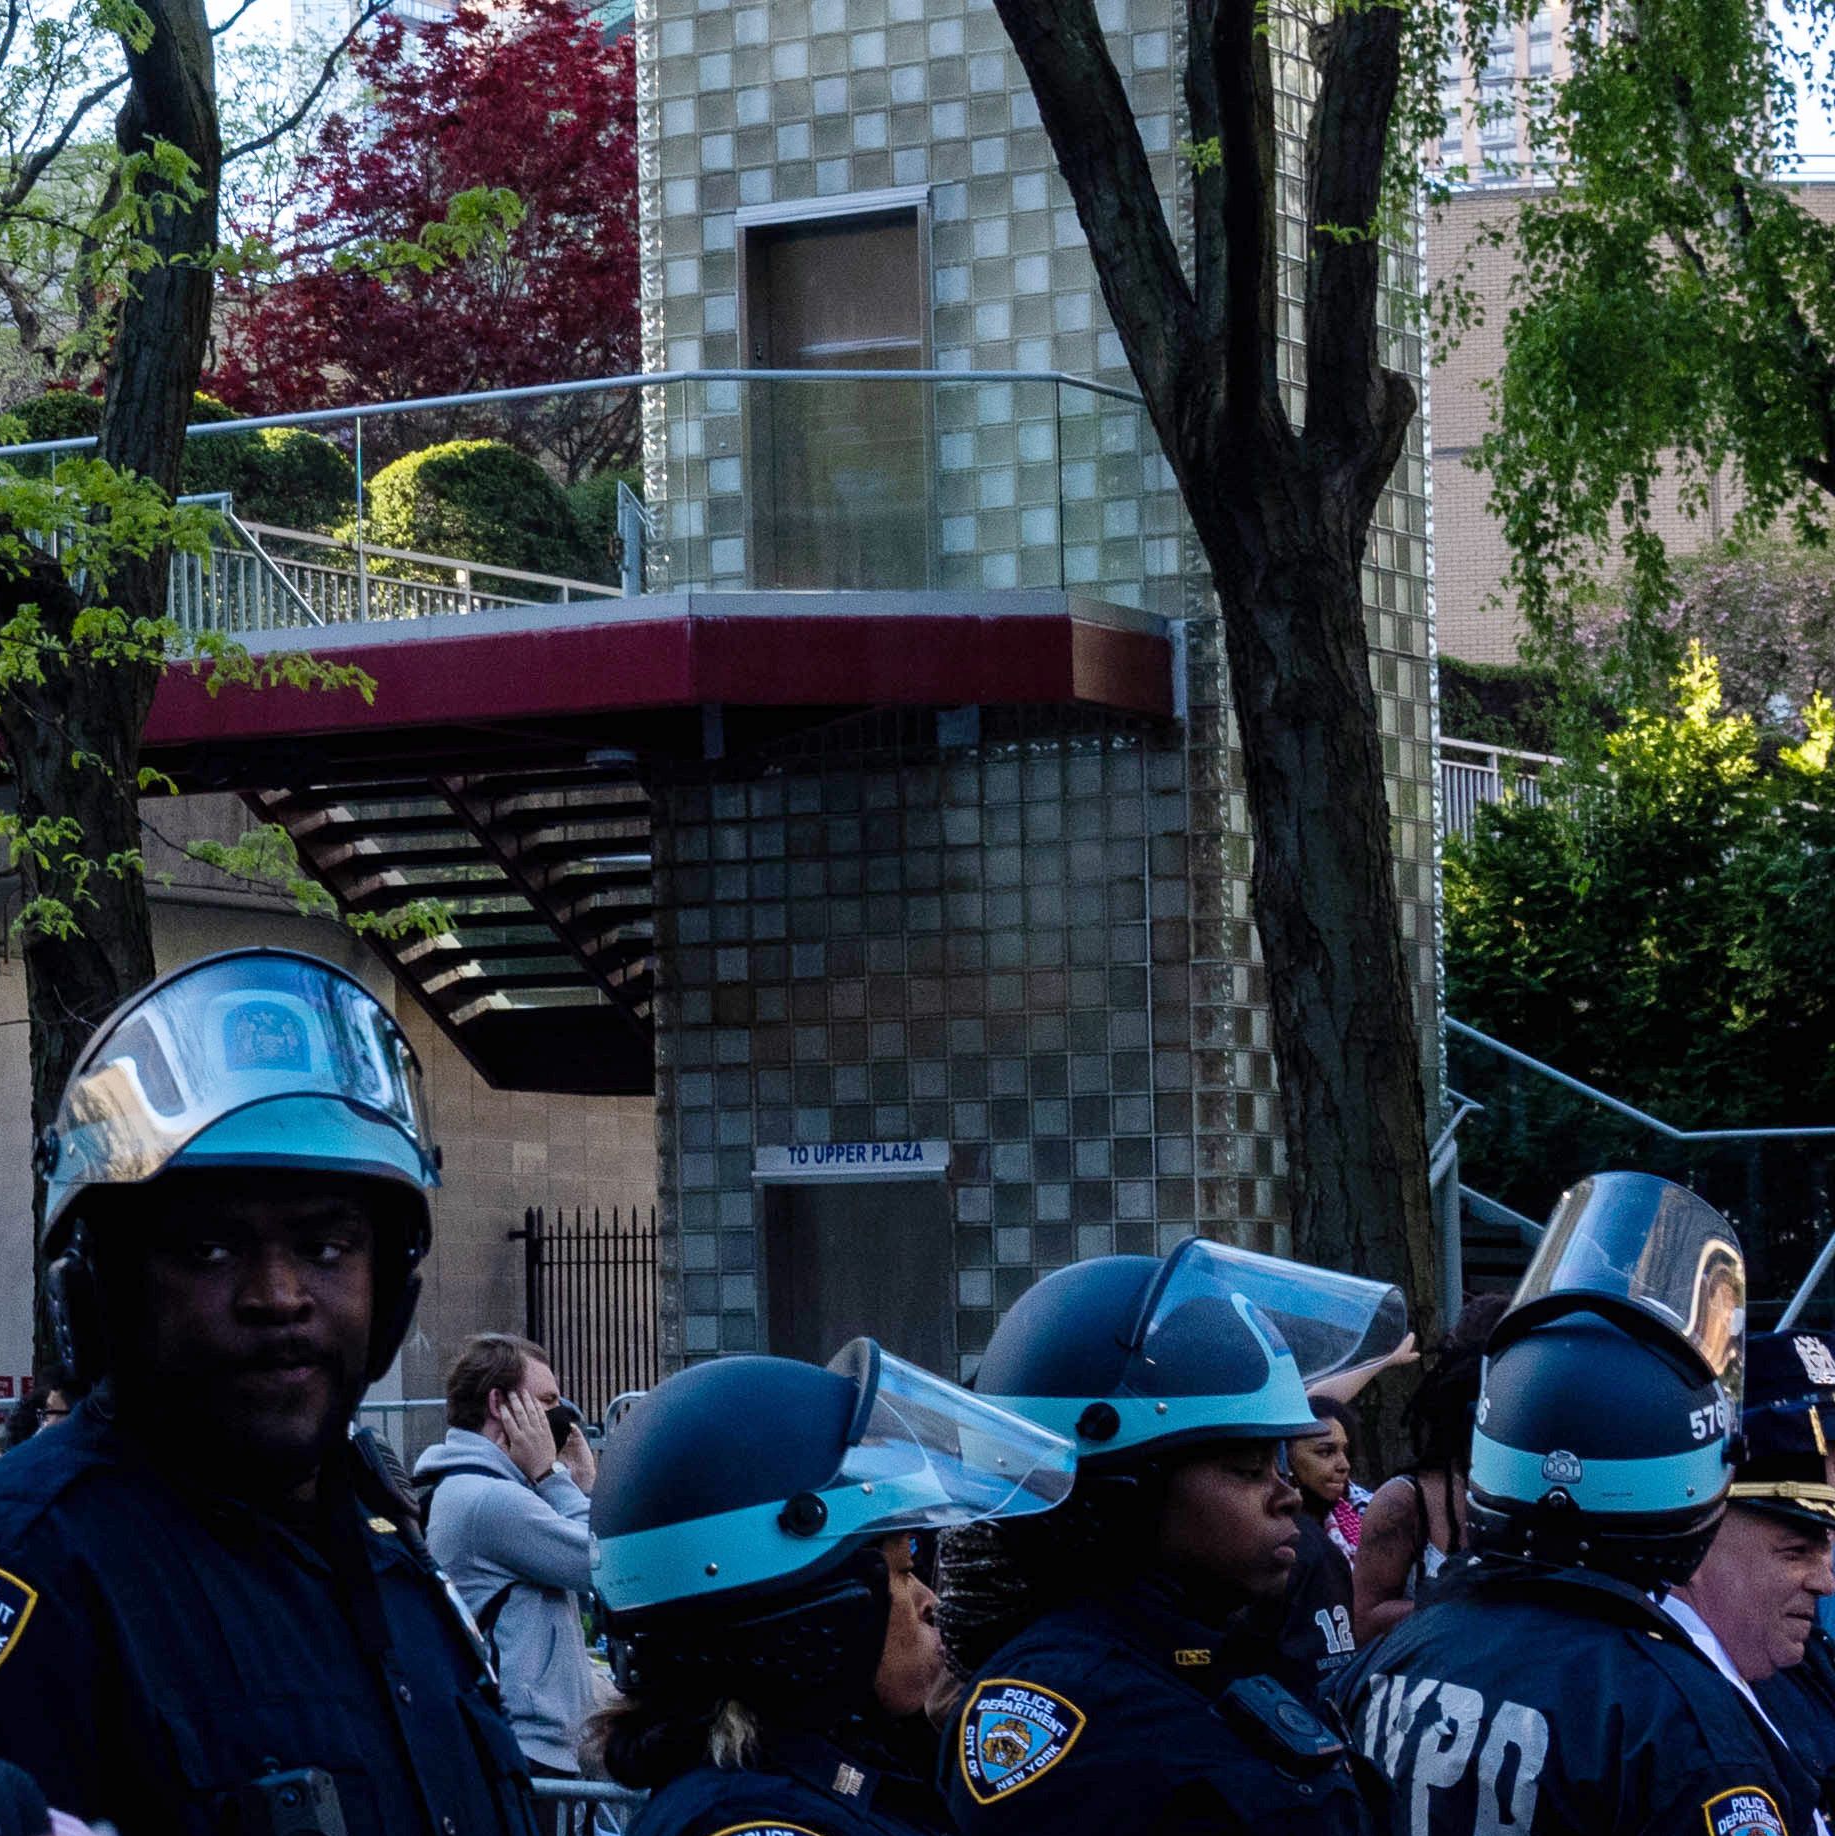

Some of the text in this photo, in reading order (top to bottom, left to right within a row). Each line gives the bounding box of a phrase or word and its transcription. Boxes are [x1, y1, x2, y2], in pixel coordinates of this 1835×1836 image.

[788, 1141, 924, 1164] TO UPPER PLAZA
[1315, 1604, 1355, 1654] 12
[976, 1698, 1068, 1738] DEPARTMENT
[1002, 1687, 1057, 1715] POLICE
[965, 1725, 980, 1778] CITY OF
[995, 1743, 1062, 1792] NEW YORK
[1731, 1796, 1767, 1812] POLICE
[1718, 1809, 1782, 1836] DEPARTMENT
